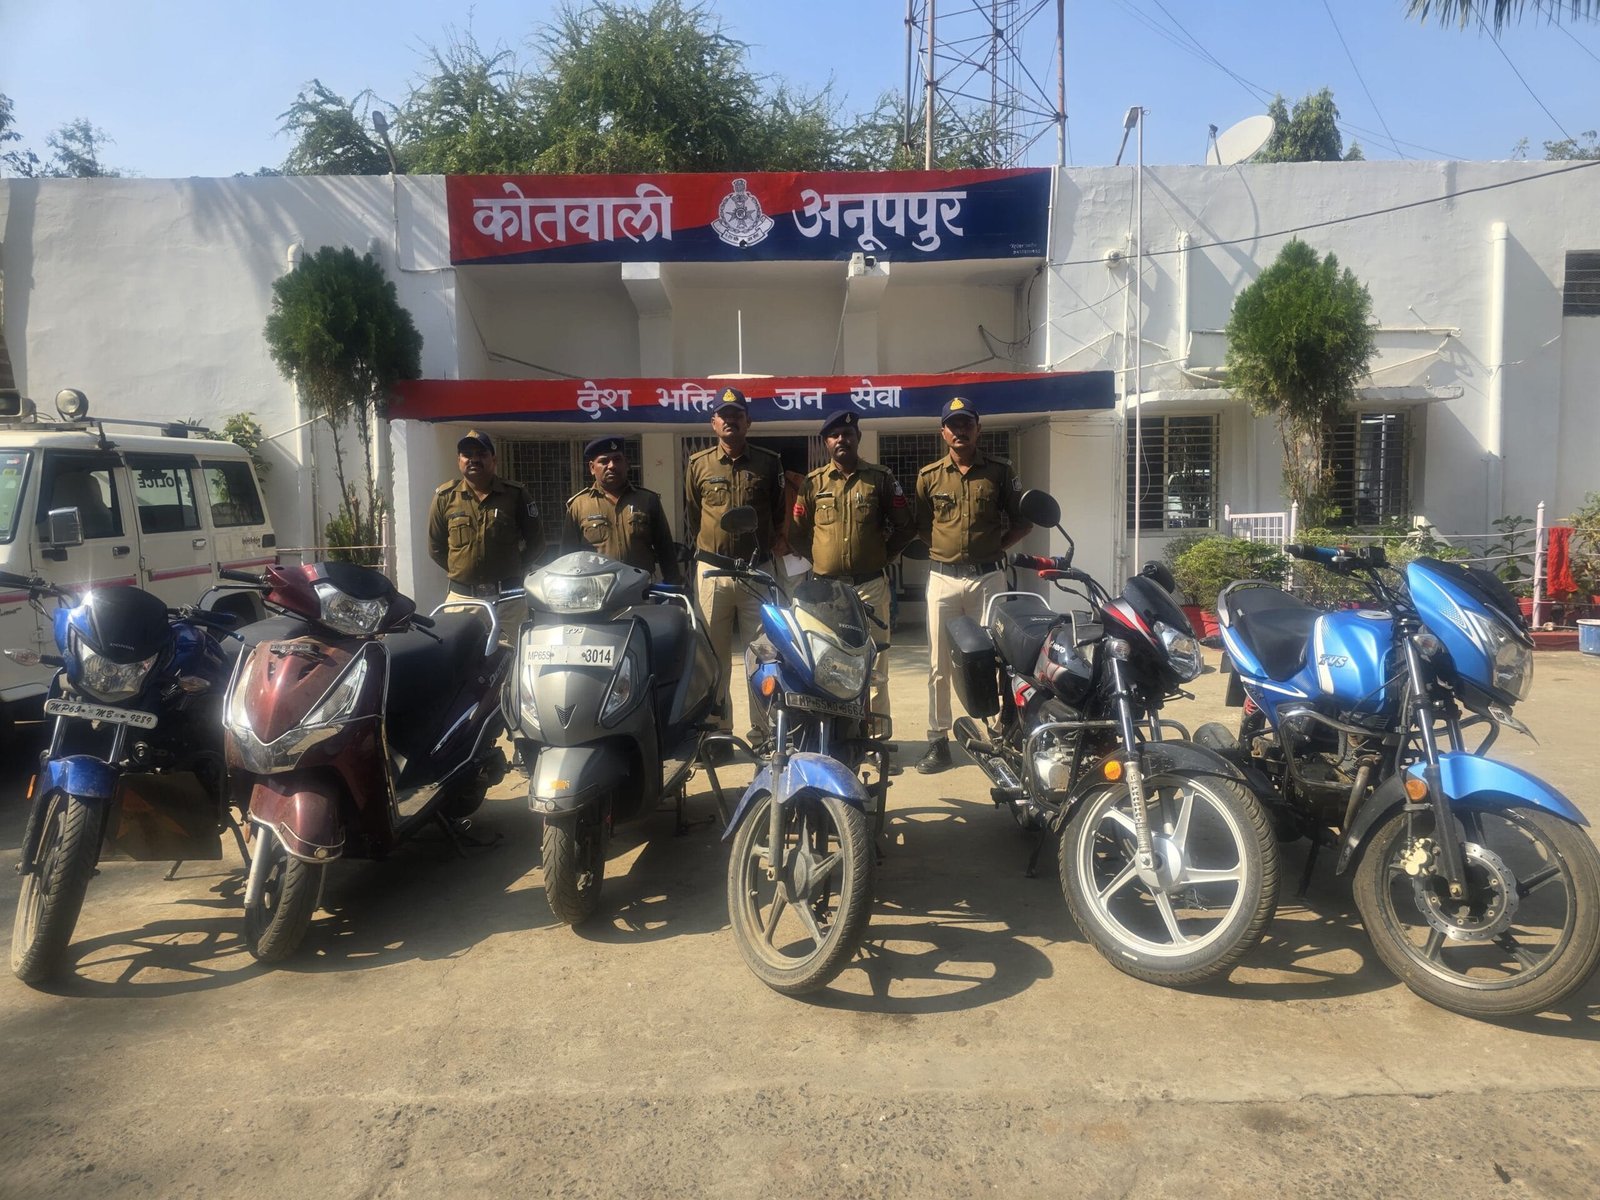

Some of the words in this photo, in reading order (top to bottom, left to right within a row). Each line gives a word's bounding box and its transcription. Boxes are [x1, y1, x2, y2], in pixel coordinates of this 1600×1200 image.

[472, 182, 673, 243] कोतवाली
[792, 188, 967, 252] अनूपपुर
[576, 380, 632, 420] देश
[772, 387, 827, 411] जन
[850, 378, 902, 410] सेवा
[584, 648, 612, 663] 3014
[1318, 653, 1349, 668] TVS
